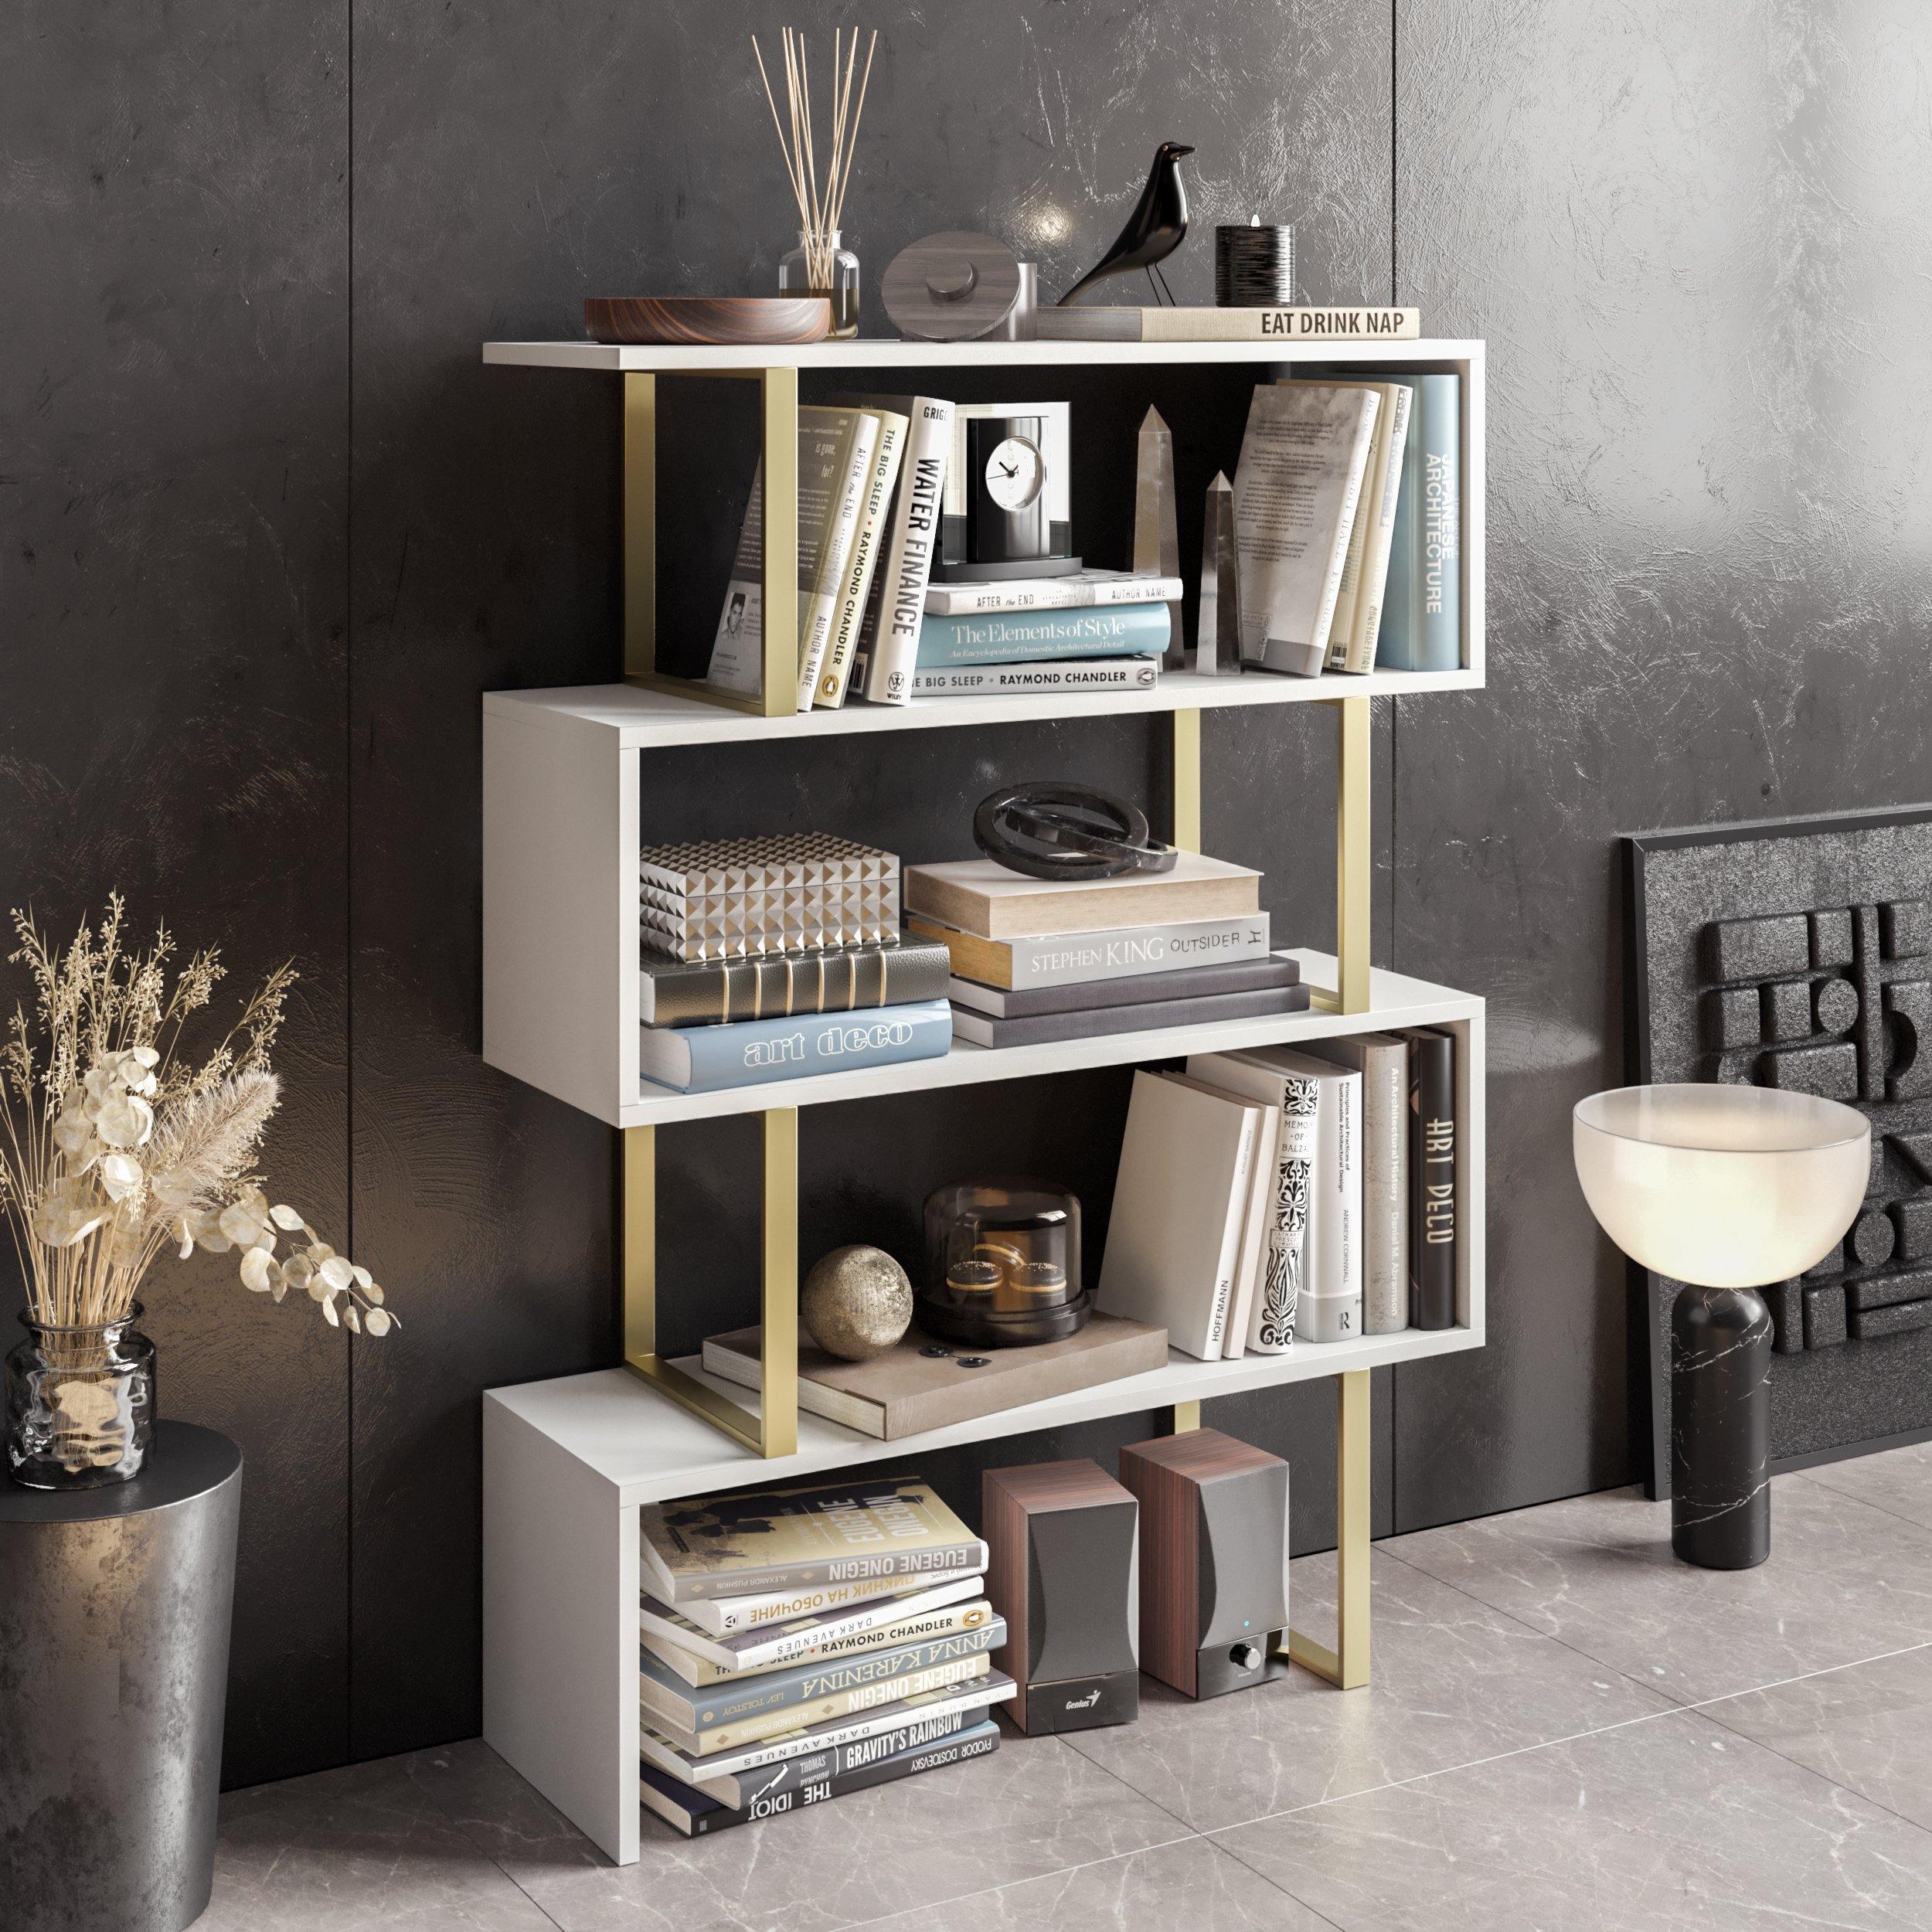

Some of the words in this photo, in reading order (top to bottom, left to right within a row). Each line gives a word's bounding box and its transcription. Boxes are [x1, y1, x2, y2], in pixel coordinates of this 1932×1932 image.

[1261, 313, 1294, 334] EAT
[1301, 312, 1359, 334] DRINK
[1367, 312, 1404, 333] NAP
[883, 430, 895, 451] THE
[852, 447, 866, 478] AFTER
[877, 456, 889, 476] BIG
[869, 481, 883, 515] SLEEP
[908, 459, 940, 532] WATER
[1440, 453, 1454, 560] JAPANESE
[842, 499, 855, 519] END
[1427, 453, 1441, 614] ARCHITECTURE
[850, 532, 871, 595] RAYMOND
[892, 539, 927, 637] FINANCE
[977, 597, 1001, 607] AFTER
[1018, 594, 1034, 605] END
[1111, 589, 1141, 600] AUTHOR
[1145, 587, 1166, 597] NAME
[810, 615, 827, 655] AUTHOR
[832, 600, 855, 665] CHANDLER
[952, 625, 986, 644] The
[988, 622, 1064, 642] Elements
[1066, 619, 1083, 638] of
[1085, 617, 1126, 639] Style
[963, 647, 1011, 658] Encyclopedia
[1012, 646, 1021, 655] of
[1021, 645, 1055, 654] Domestic
[1056, 641, 1102, 652] Architectural
[802, 660, 816, 688] NAME
[926, 677, 945, 687] BIG
[951, 676, 983, 686] SLEEP
[1000, 674, 1060, 685] RAYMOND
[1066, 672, 1126, 683] CHANDLER
[887, 692, 902, 701] WILEY
[1032, 947, 1102, 972] STEPHEN
[1106, 937, 1163, 966] KING
[1171, 932, 1240, 953] OUTSIDER
[744, 1033, 804, 1066] art
[818, 1021, 913, 1056] deco
[1391, 1068, 1399, 1083] An
[1284, 1120, 1313, 1129] MEMO
[1391, 1086, 1400, 1159] Architectural
[1427, 1117, 1454, 1165] ART
[1390, 1161, 1400, 1201] History
[1427, 1183, 1454, 1243] DECO
[1391, 1212, 1400, 1243] Daniel
[1391, 1244, 1400, 1260] M.
[1212, 1280, 1229, 1342] HOFFMANN
[818, 1498, 885, 1543] EUGENE
[862, 1494, 930, 1538] ONEGIN
[828, 1556, 894, 1581] ONEGIN
[900, 1549, 968, 1573] EUGENE
[716, 1577, 749, 1590] PUSHKIN
[750, 1573, 788, 1586] ALEXANDR
[750, 1594, 823, 1622] ОБОЧИНЕ
[828, 1590, 849, 1604] НА
[821, 1633, 885, 1654] RAYMOND
[889, 1617, 952, 1639] CHANDLER
[840, 1617, 872, 1638] DARK
[777, 1630, 835, 1655] AVENUES
[927, 1630, 995, 1664] ANNA
[802, 1655, 924, 1699] KARENINA
[914, 1658, 978, 1693] EUGENE
[723, 1696, 764, 1716] TOLSTOY
[764, 1690, 786, 1704] LEV
[849, 1679, 910, 1712] ONEGIN
[1066, 1699, 1090, 1709] Genius
[741, 1723, 772, 1739] PUSHKIN
[773, 1712, 809, 1731] ALEXANDR
[828, 1726, 870, 1743] DARK
[910, 1711, 962, 1748] RAINBOW
[744, 1741, 821, 1766] AVENUES
[911, 1749, 957, 1772] DOSTOEVSKY
[961, 1738, 992, 1757] FYODOR
[800, 1755, 826, 1774] THOMAS
[804, 1781, 832, 1805] THE
[748, 1792, 792, 1821] IDIOT
